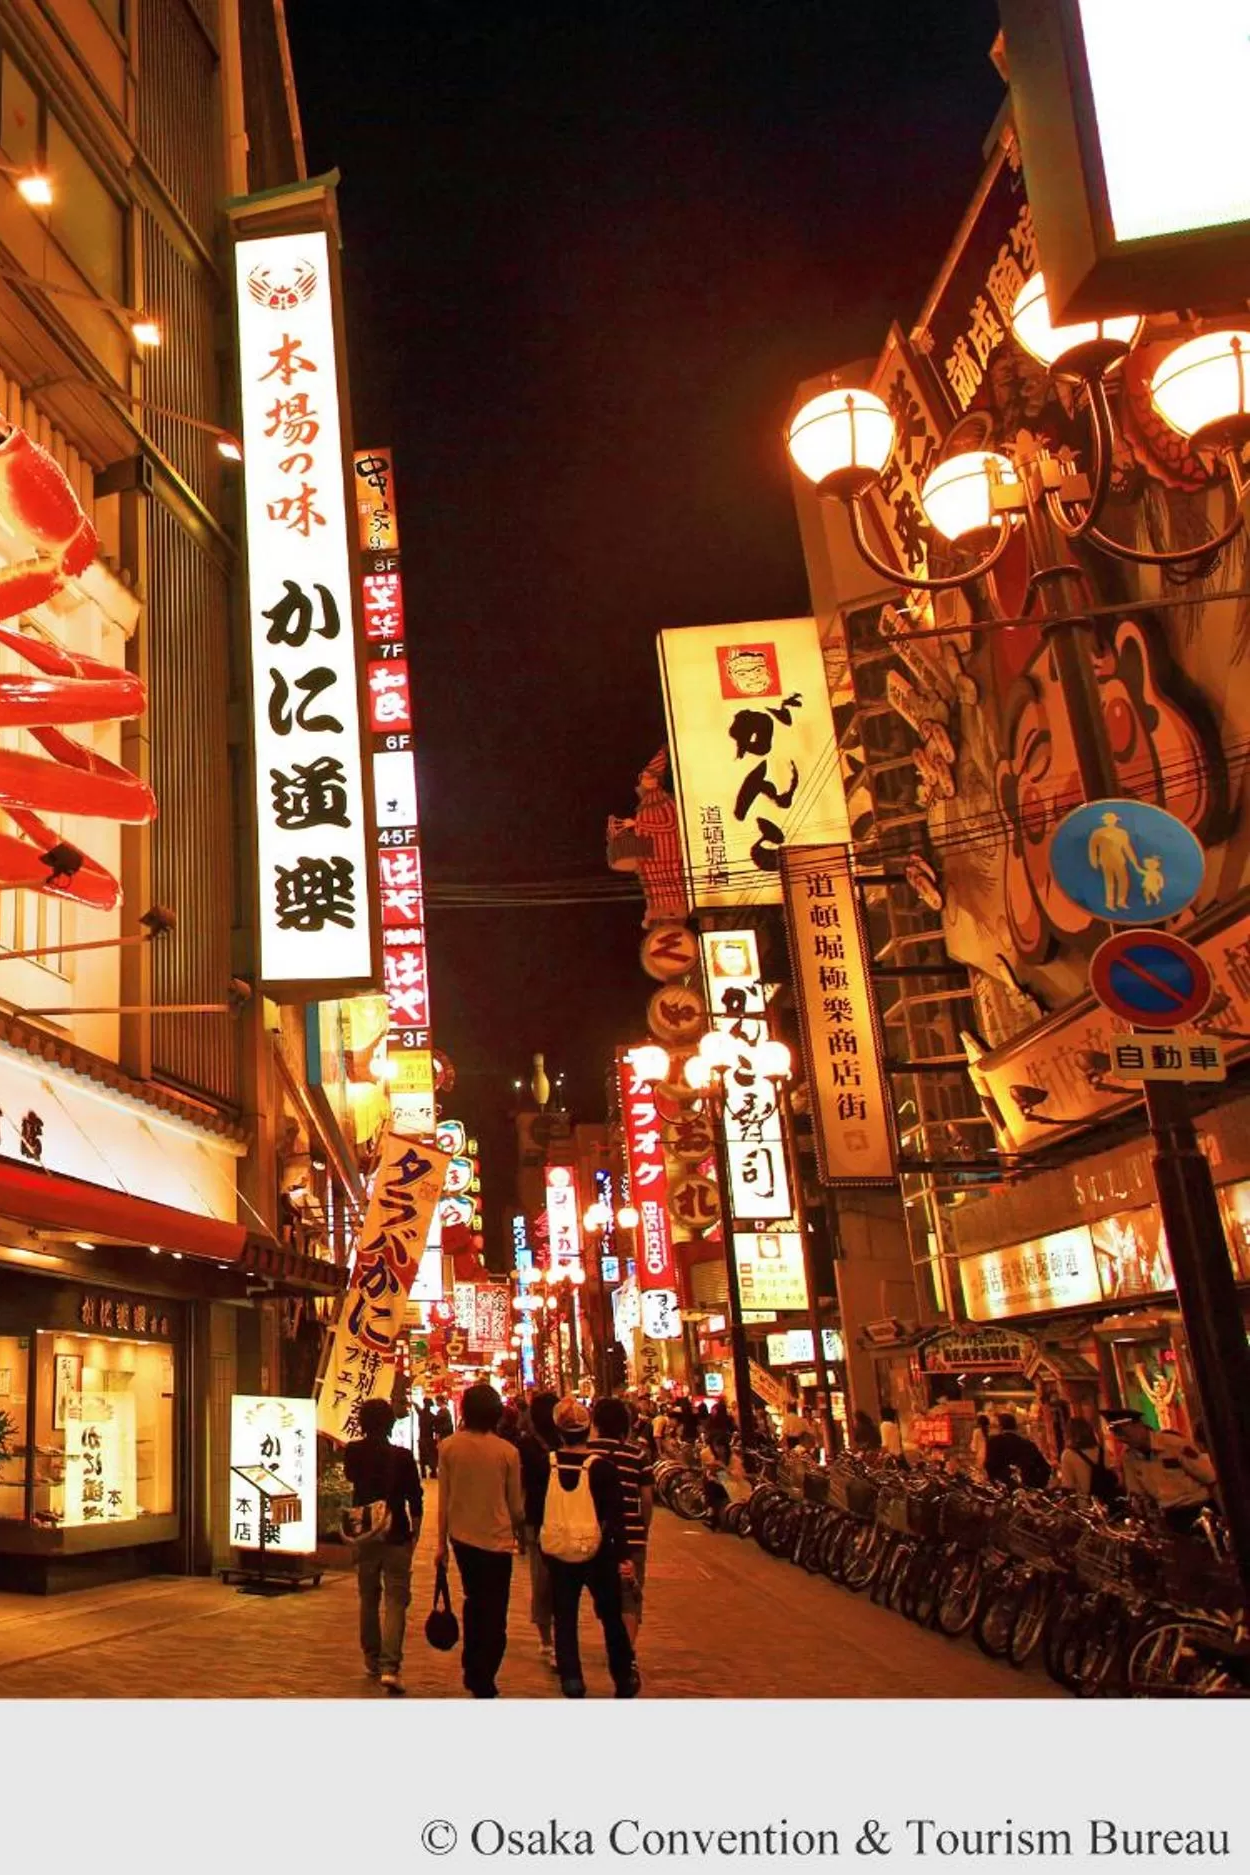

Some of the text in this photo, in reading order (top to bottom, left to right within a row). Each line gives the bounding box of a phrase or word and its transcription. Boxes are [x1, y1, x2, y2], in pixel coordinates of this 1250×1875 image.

[257, 333, 327, 538] 本場の味
[374, 560, 397, 572] 8F
[380, 644, 404, 659] 7F
[385, 735, 410, 750] 6F
[728, 692, 802, 872] がんこ
[403, 1032, 428, 1048] 3F
[1116, 1044, 1219, 1071] 自動車
[349, 1147, 434, 1346] タラバかに
[234, 1497, 253, 1542] 本店
